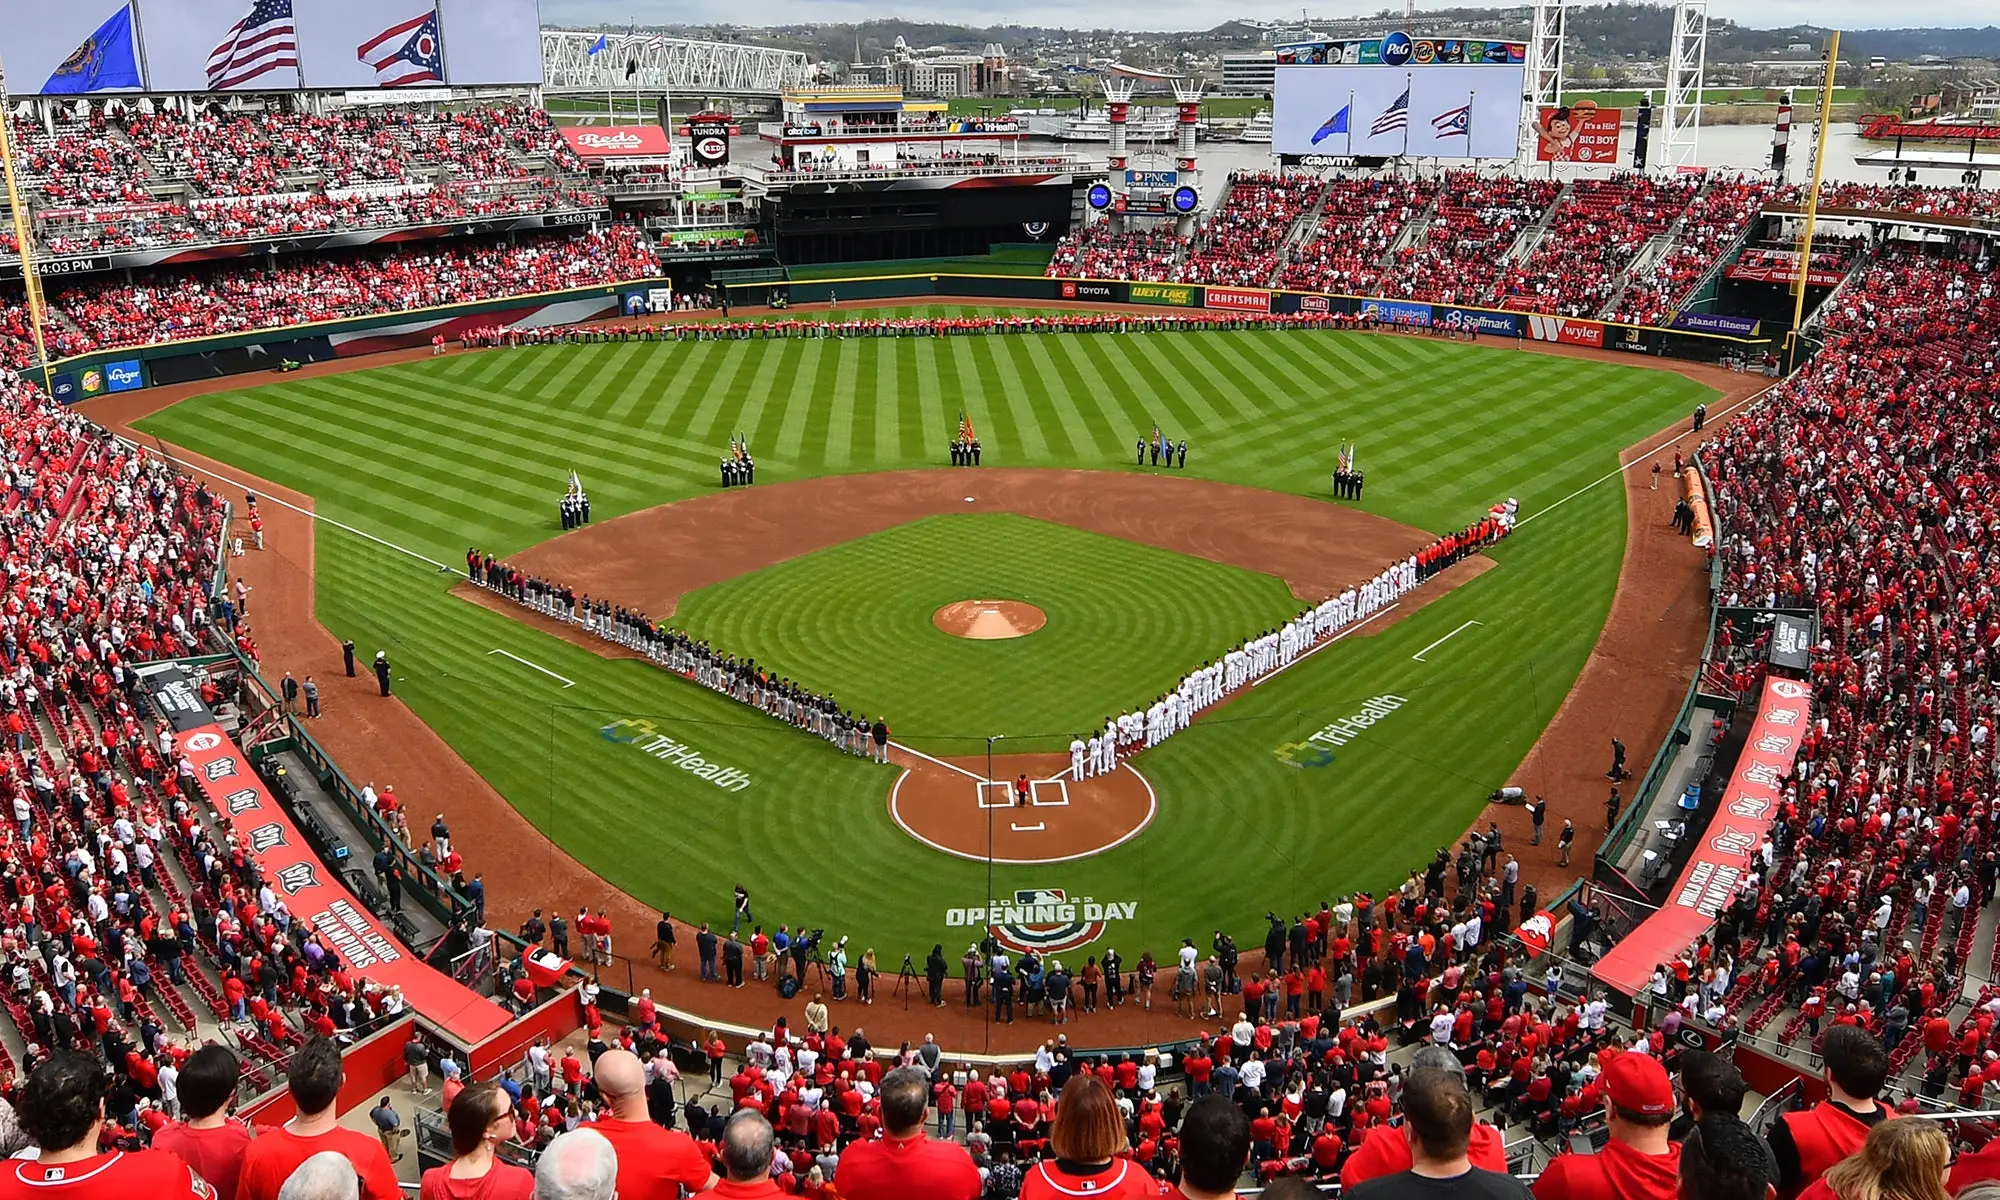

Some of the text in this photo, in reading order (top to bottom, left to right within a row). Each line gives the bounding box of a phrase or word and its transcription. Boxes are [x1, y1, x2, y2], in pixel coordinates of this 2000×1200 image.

[1386, 42, 1410, 55] P&G
[1414, 44, 1433, 58] Tide
[384, 91, 449, 100] ULTIMATE JET
[692, 128, 726, 136] TUNDRA
[984, 122, 1019, 132] TriHealth
[1812, 118, 1821, 142] WAY
[577, 132, 643, 147] Reds
[1579, 135, 1615, 145] BIG BOY
[705, 144, 726, 152] REDS
[1306, 156, 1355, 166] GRAVITY
[1144, 172, 1169, 182] PNC
[554, 213, 601, 225] 3:54:03 PM
[72, 260, 93, 271] PM
[1079, 287, 1110, 295] TOYOTA
[1132, 287, 1190, 299] WEST LAKE
[1208, 293, 1267, 306] CRAFTSMAN
[1303, 299, 1327, 309] Swift
[1390, 307, 1429, 322] Elizabeth
[1463, 315, 1512, 331] Staffmark
[1687, 317, 1751, 331] planet fitness
[1564, 326, 1600, 340] wyler
[1616, 341, 1648, 352] BETMGM
[108, 369, 140, 384] Kroger
[1308, 694, 1408, 746] TriHealth
[640, 734, 751, 792] TriHealth
[228, 789, 255, 812] 1961
[252, 824, 281, 849] 1970
[1717, 832, 1752, 851] 1919
[280, 864, 312, 891] 1972
[1676, 860, 1715, 908] WORLD SERIES
[1696, 864, 1740, 918] CHAMPIONS
[946, 901, 1138, 926] OPENING DAY
[329, 899, 401, 964] NATIONAL LEAGUE
[310, 910, 378, 969] CHAMPIONS
